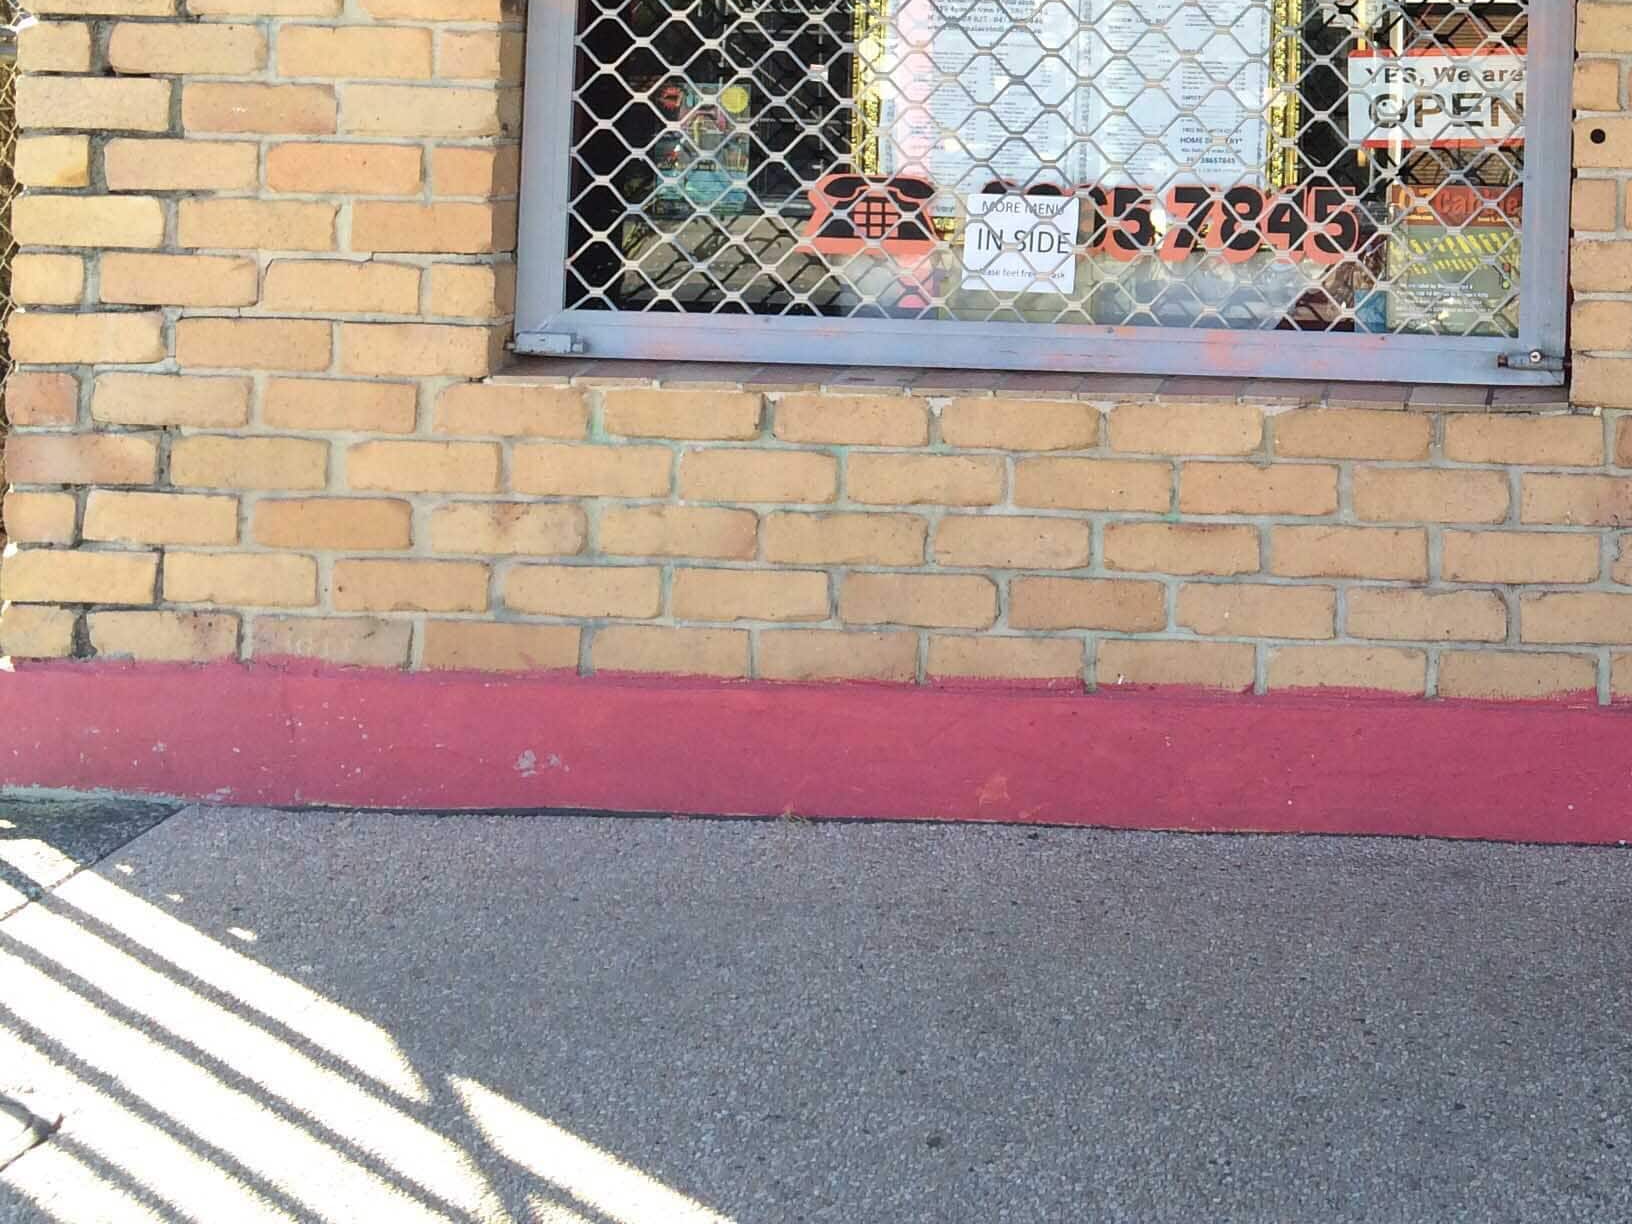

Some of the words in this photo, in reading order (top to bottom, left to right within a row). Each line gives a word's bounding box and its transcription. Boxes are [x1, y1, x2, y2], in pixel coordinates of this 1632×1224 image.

[1366, 66, 1425, 85] YES,
[1433, 66, 1470, 83] We
[1482, 67, 1525, 83] are
[1368, 91, 1525, 129] OPEN
[982, 200, 1021, 214] MORE
[1024, 202, 1065, 216] MENU
[1170, 184, 1357, 256] 7845
[977, 227, 1004, 251] IN
[1013, 229, 1072, 254] SIDE
